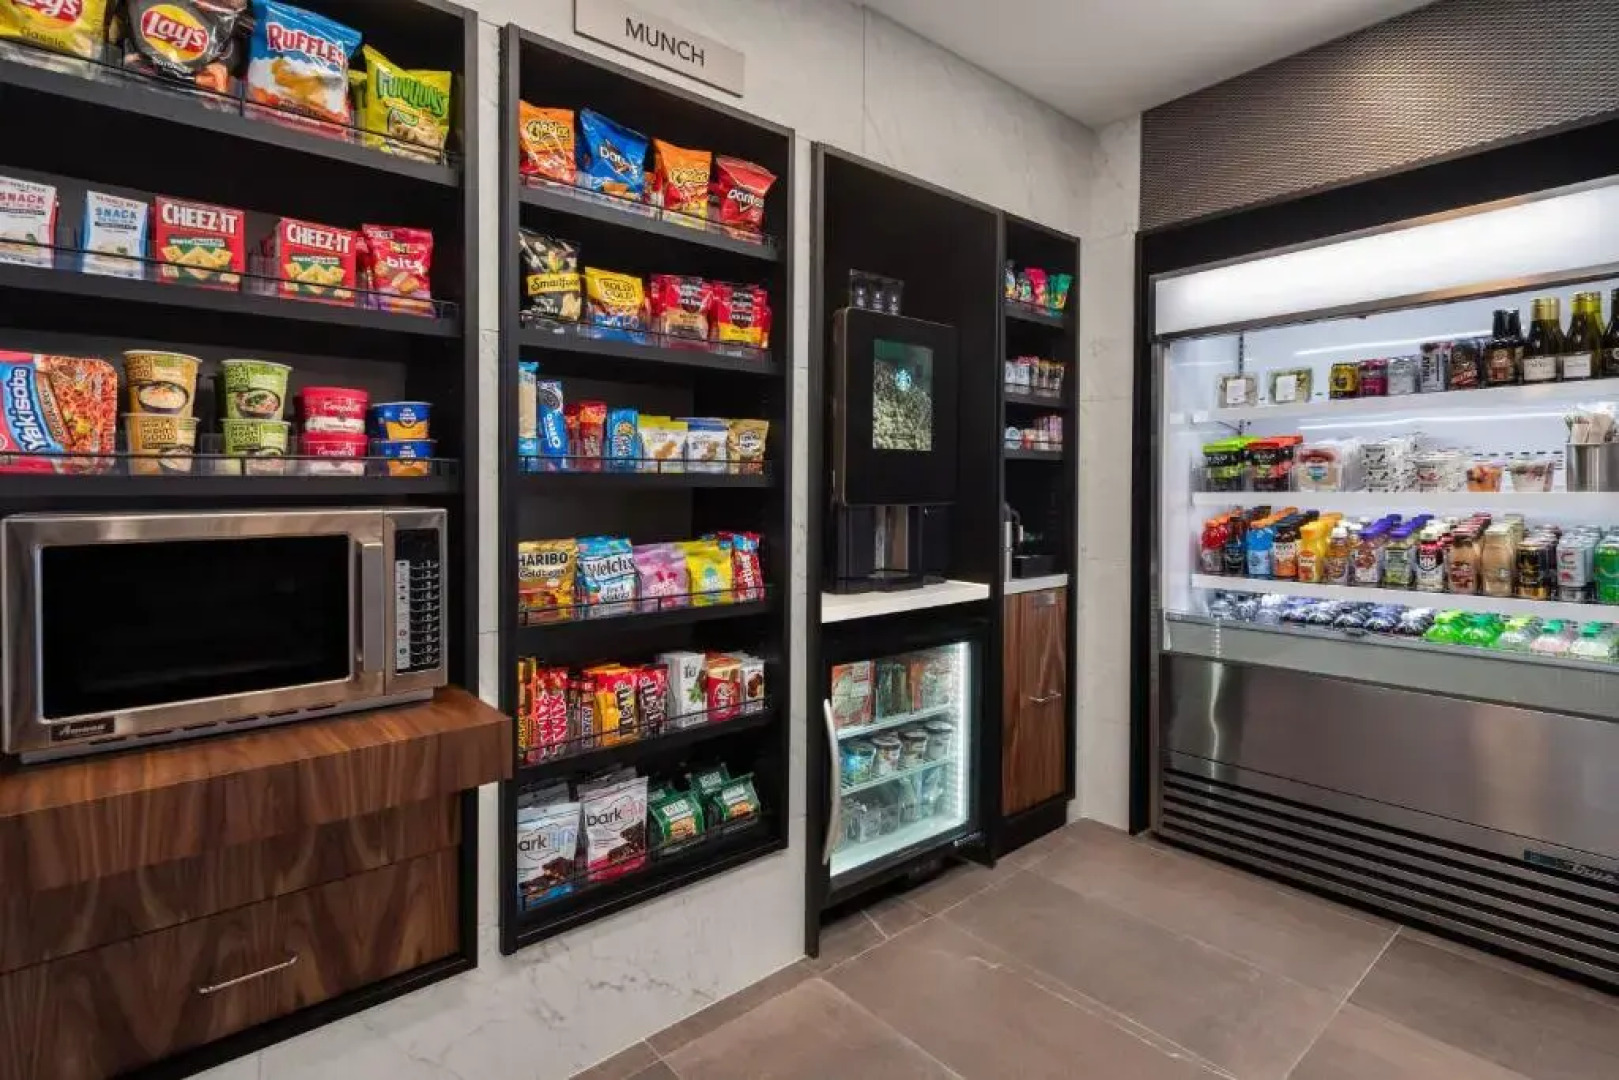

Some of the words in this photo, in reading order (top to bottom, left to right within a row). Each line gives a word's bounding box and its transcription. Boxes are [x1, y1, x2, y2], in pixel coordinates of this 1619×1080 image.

[146, 11, 205, 49] Lay's
[266, 22, 347, 65] RUFFLES
[625, 17, 704, 68] MUNCH
[162, 203, 237, 234] CHEEZ-IT
[287, 223, 351, 253] CHEEZ-IT
[7, 368, 46, 450] Yakisoba
